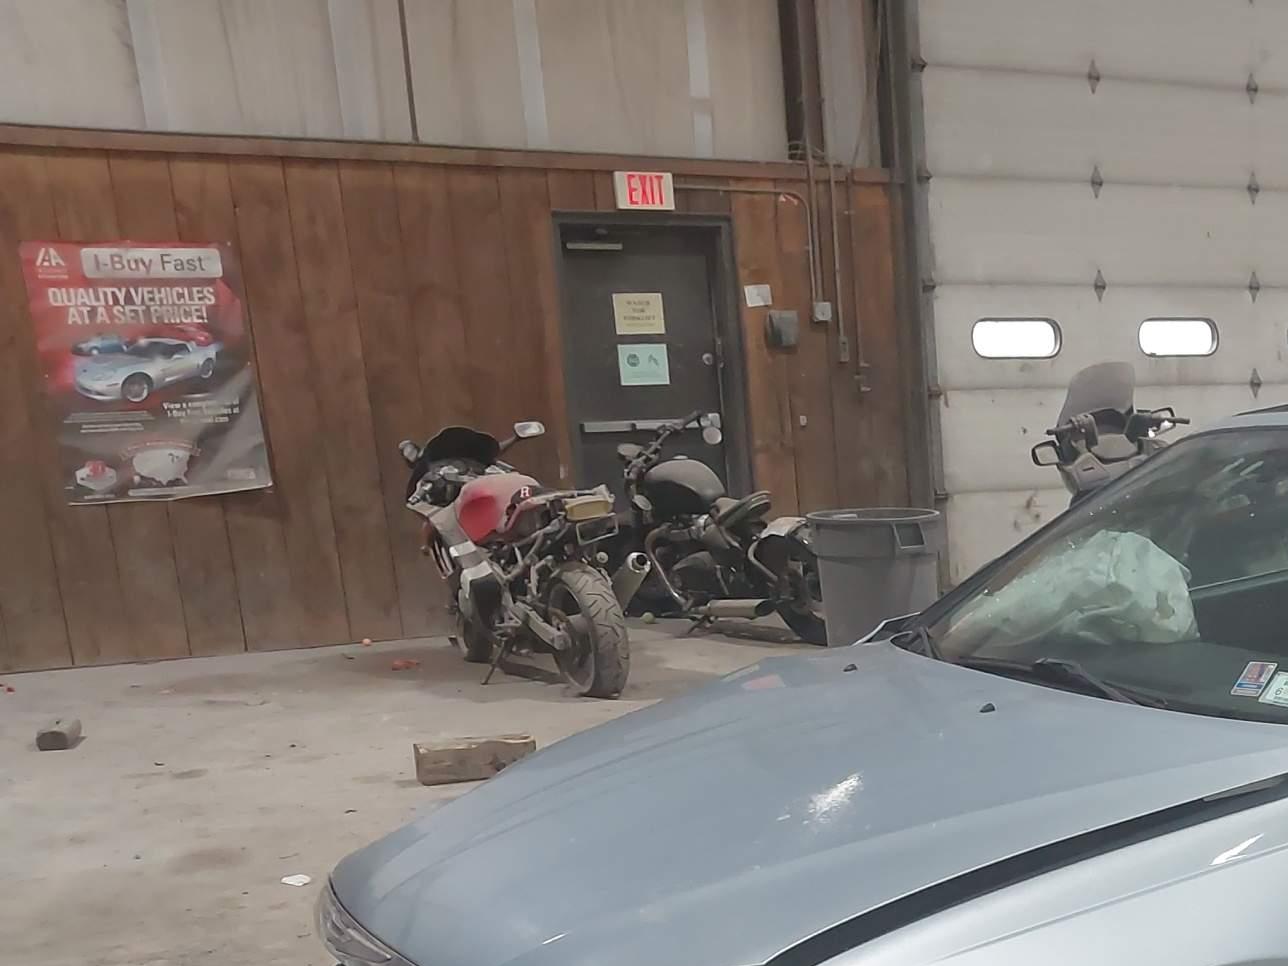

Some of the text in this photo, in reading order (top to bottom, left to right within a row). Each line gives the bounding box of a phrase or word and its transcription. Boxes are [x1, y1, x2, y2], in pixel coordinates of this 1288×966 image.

[626, 174, 665, 207] EXIT
[93, 253, 206, 275] I-Buy Fast
[48, 287, 216, 306] QUALITY VEHICLES
[67, 305, 208, 325] AT A SET PRICE!
